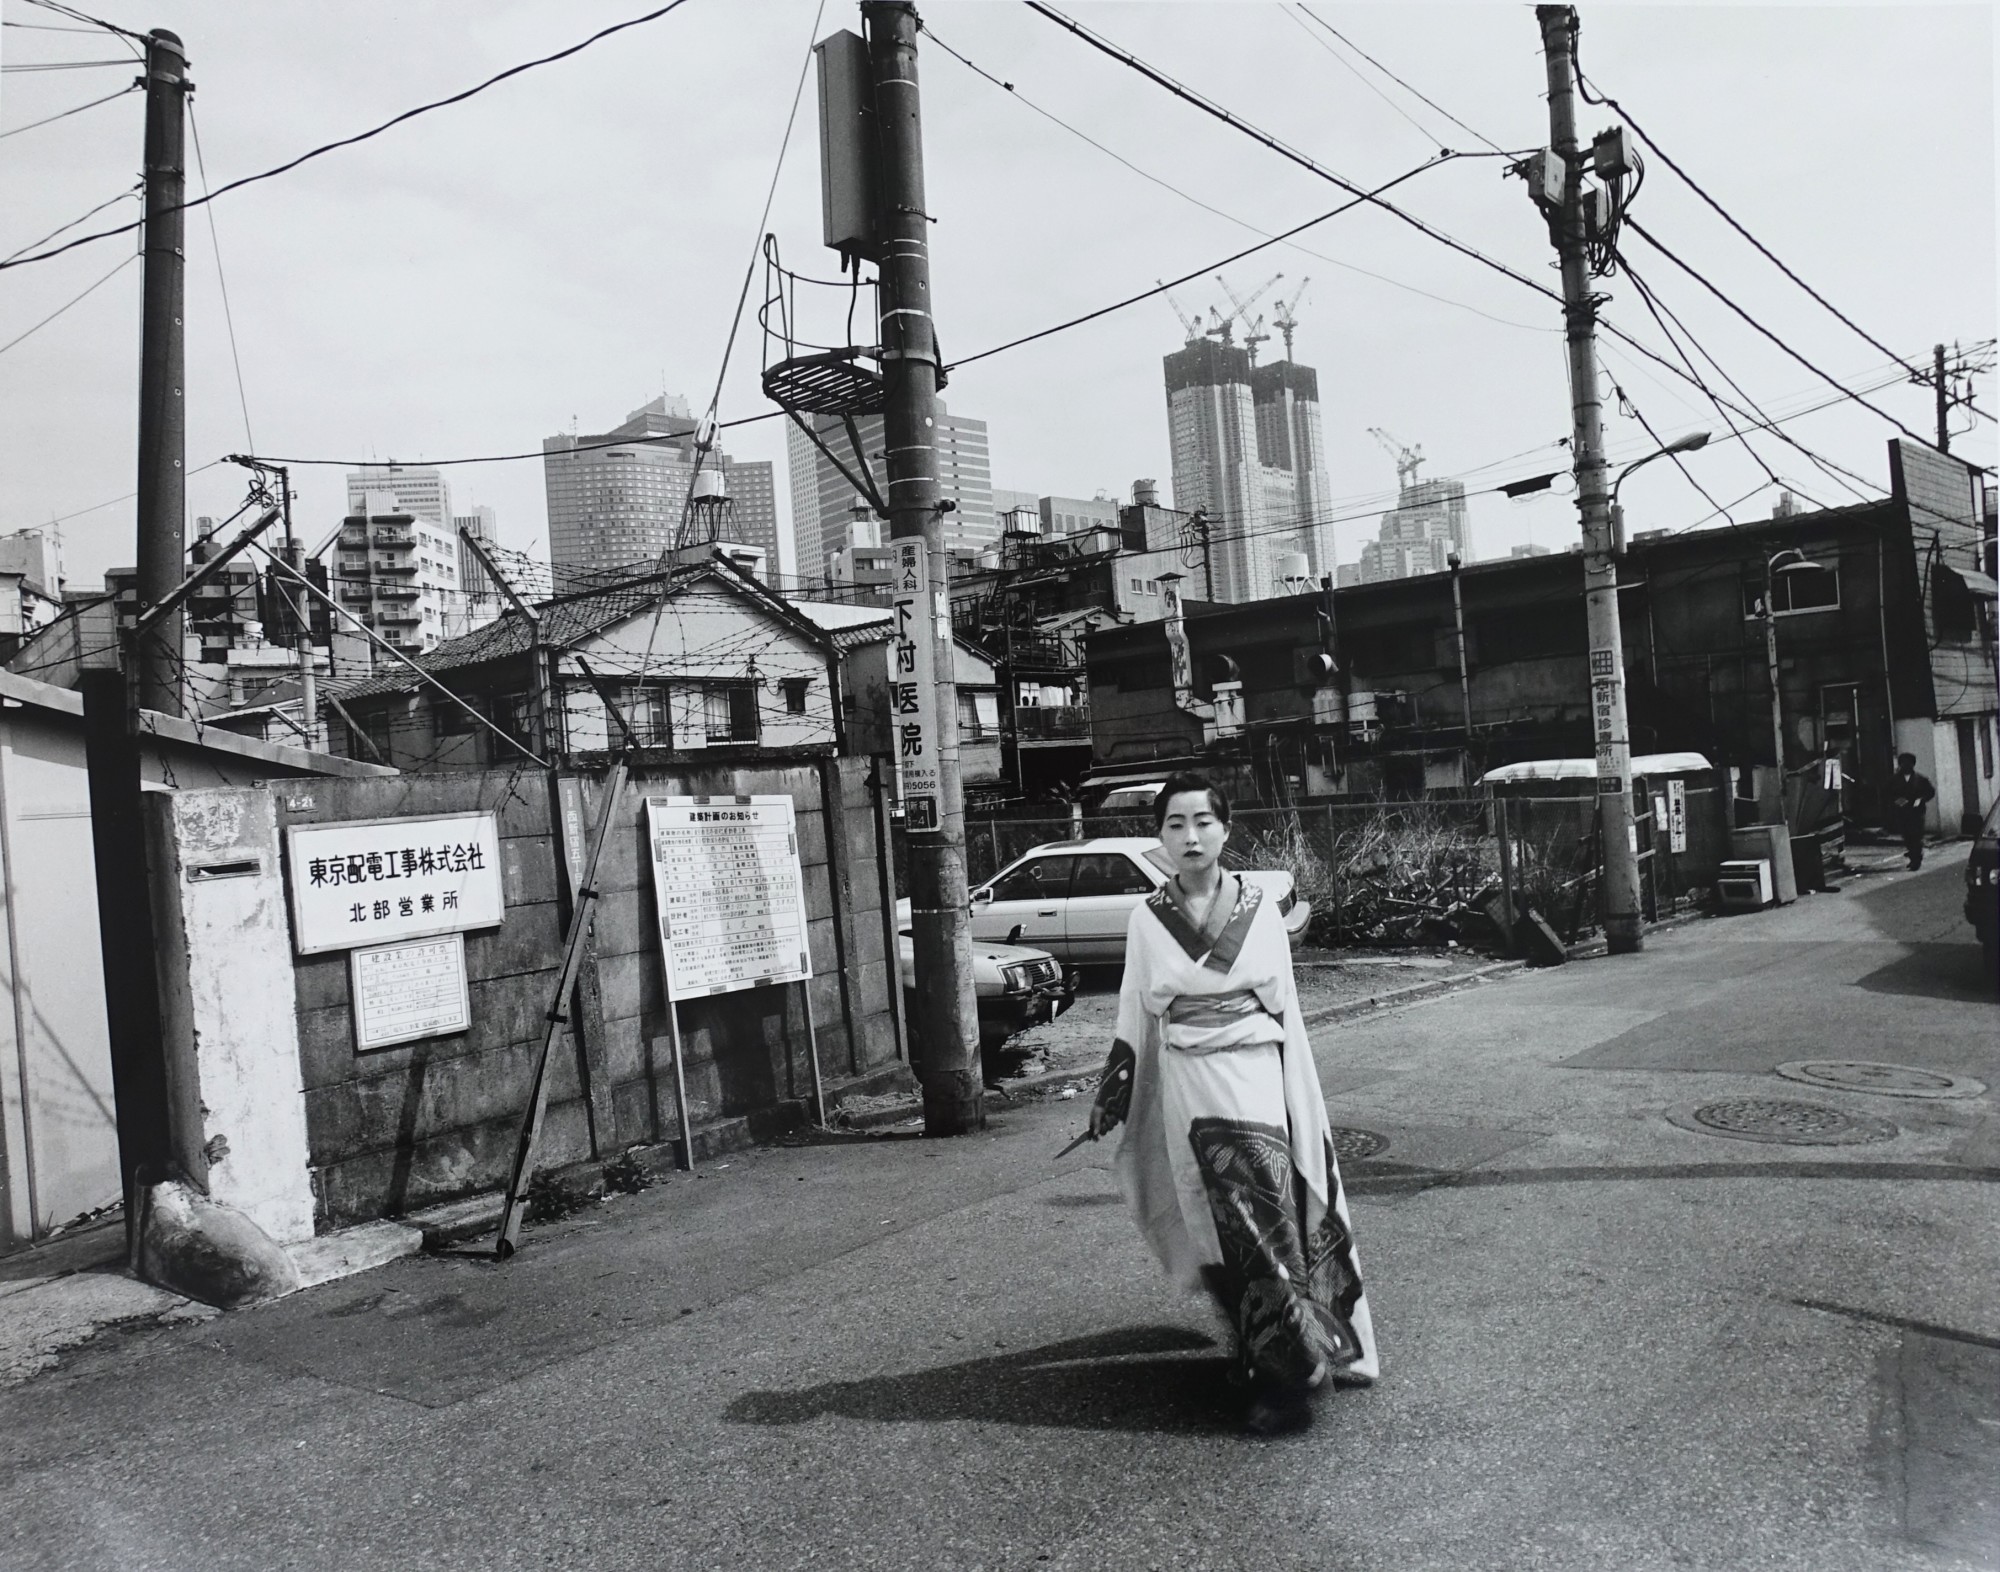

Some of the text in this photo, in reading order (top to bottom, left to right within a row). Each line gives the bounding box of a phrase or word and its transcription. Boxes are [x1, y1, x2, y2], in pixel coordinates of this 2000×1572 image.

[902, 545, 917, 591] 産婦人科
[894, 599, 922, 757] 下村医院
[289, 797, 313, 808] 4-21
[689, 811, 759, 822] 建築計画のお知らせ
[308, 842, 486, 888] 東京配電工事株式会社
[349, 890, 458, 923] 北部営業所
